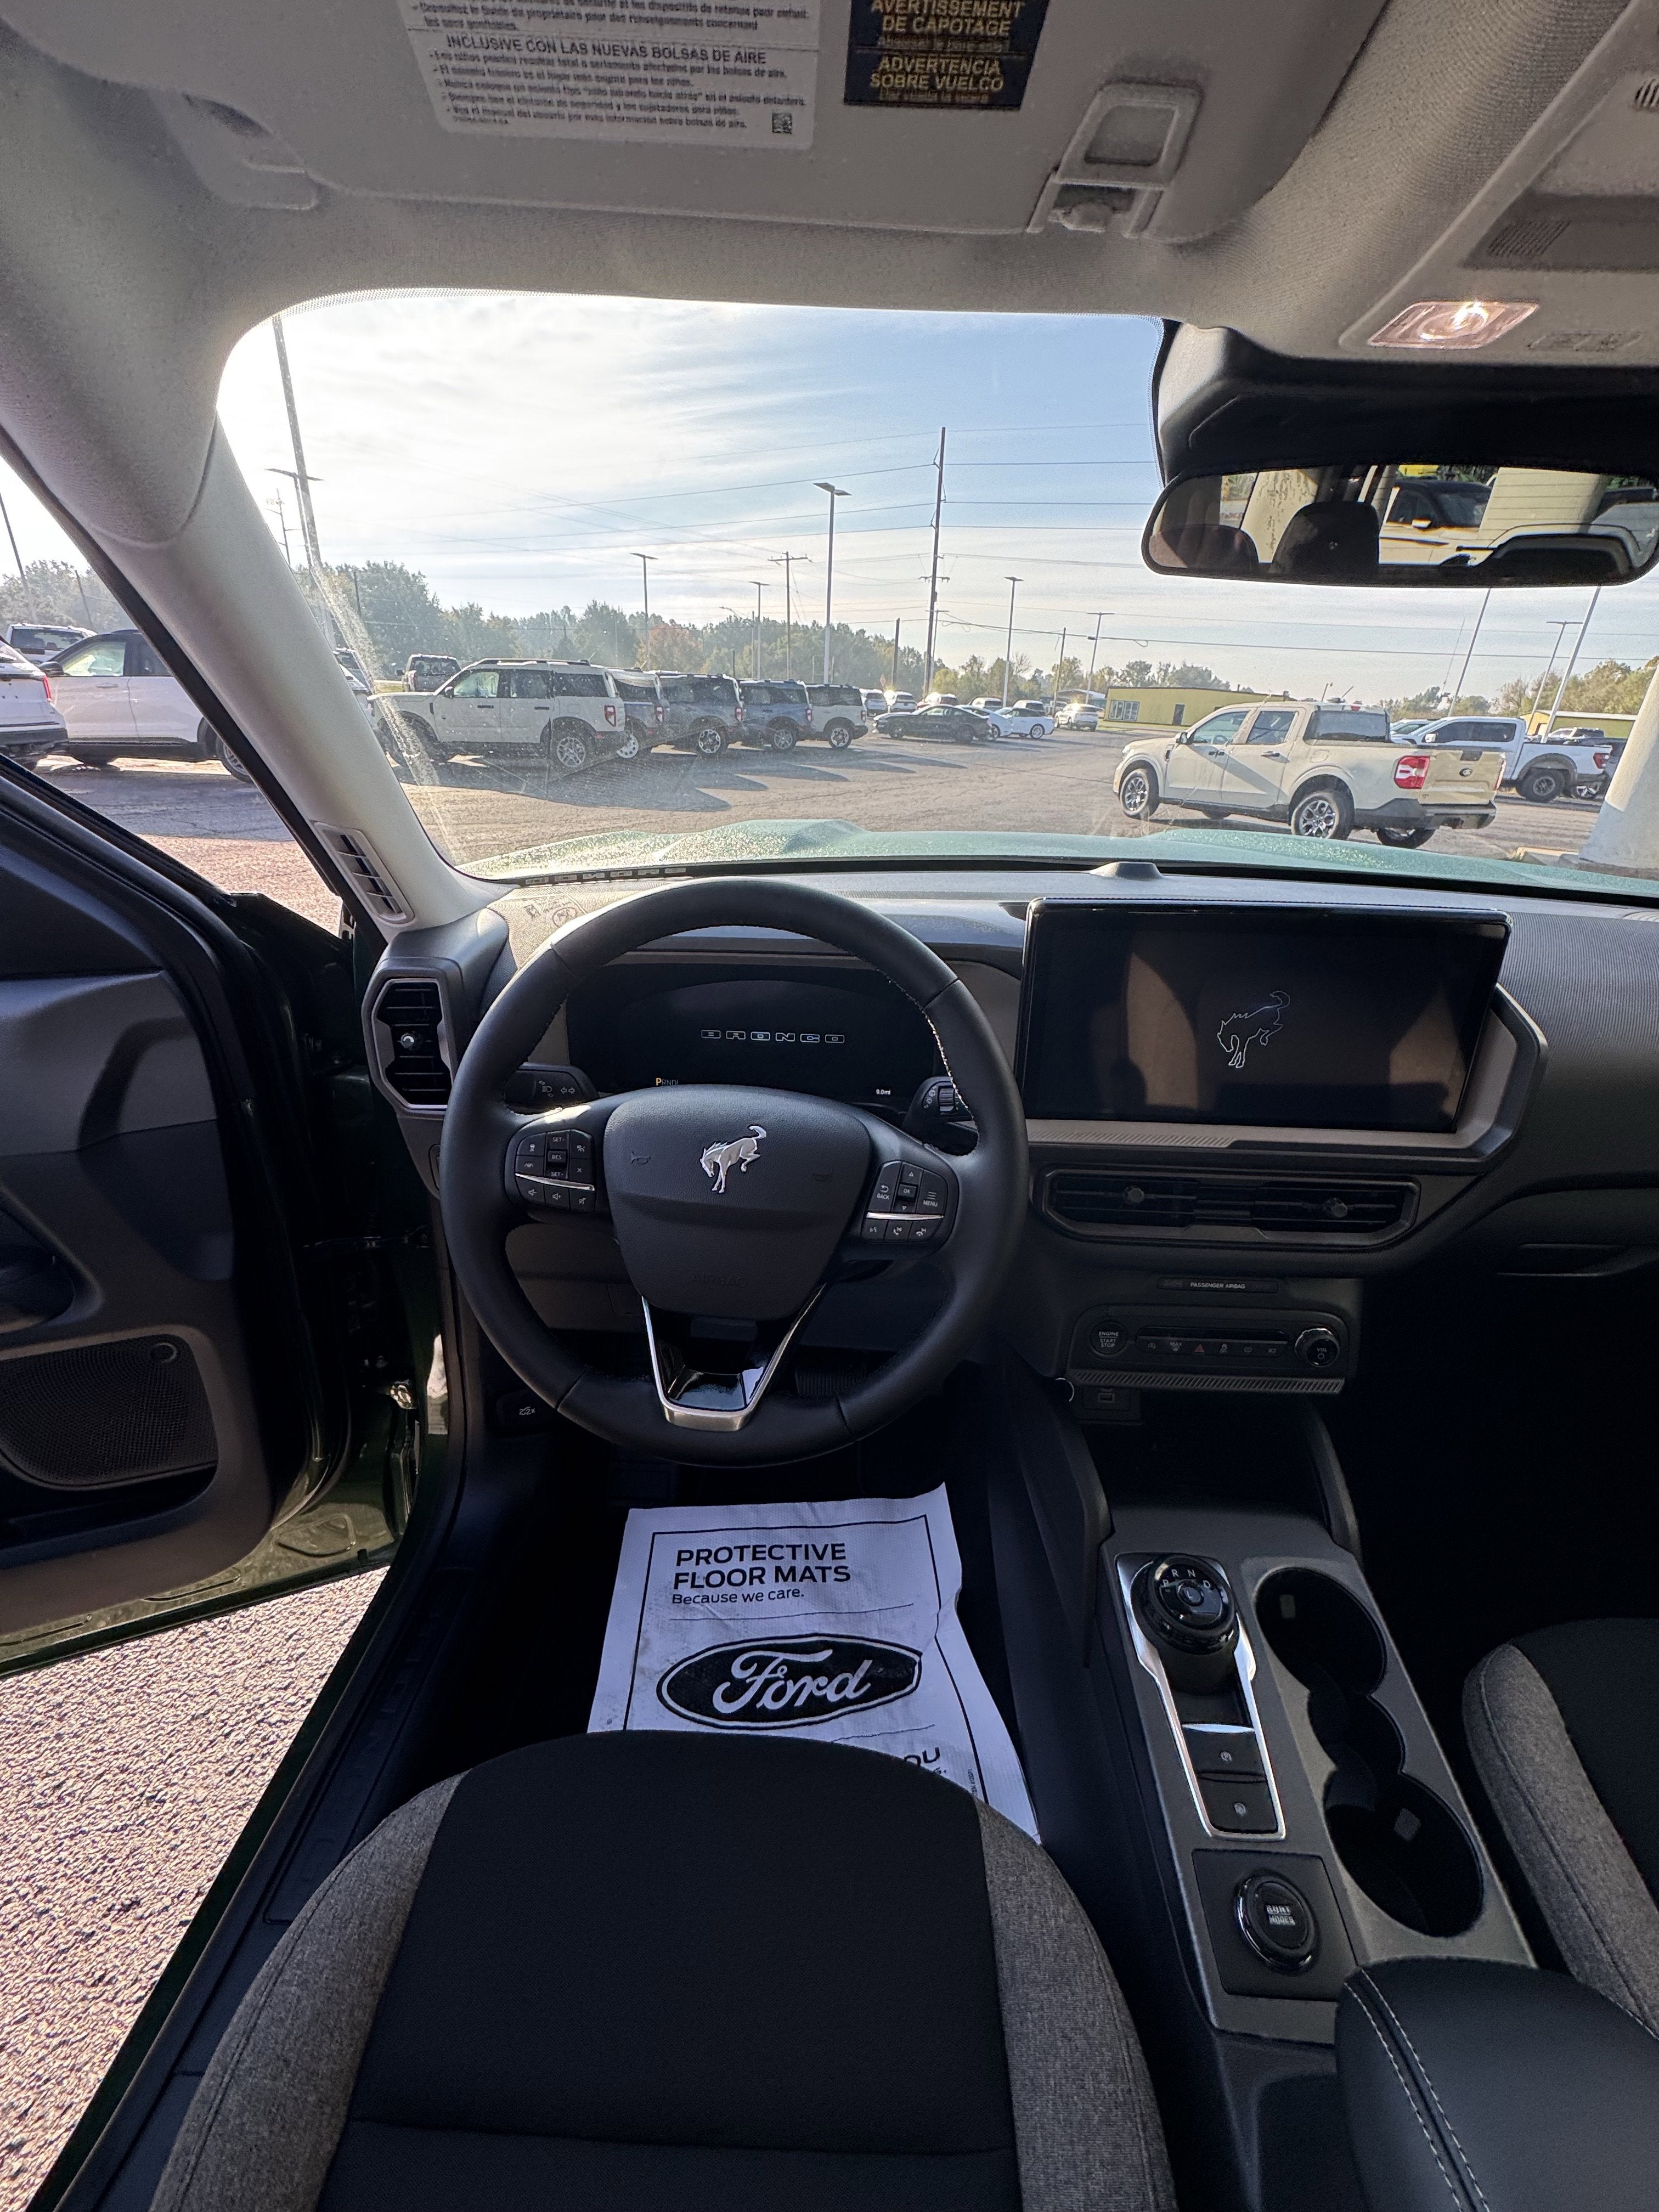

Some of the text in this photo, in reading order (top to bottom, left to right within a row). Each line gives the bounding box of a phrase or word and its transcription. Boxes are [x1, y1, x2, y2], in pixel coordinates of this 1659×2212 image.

[871, 0, 1024, 18] AVERTISSEMENT
[883, 16, 1011, 36] DE CAPOTAGE
[447, 33, 766, 64] INCLUSIVE CON LAS NUEVAS BOLSAS DE AIRE
[878, 55, 1001, 75] ADVERTENCIA
[870, 72, 1004, 92] SOBRE VUELCO
[701, 1029, 845, 1043] BRONCO
[675, 1543, 847, 1567] PROTECTIVE
[673, 1565, 851, 1590] FLOOR MATS
[1171, 1569, 1196, 1577] R N
[1163, 1579, 1211, 1588] P D
[672, 1588, 805, 1605] Because we care.
[1186, 1590, 1193, 1599] L
[712, 1649, 873, 1714] Ford
[904, 1746, 940, 1767] OU
